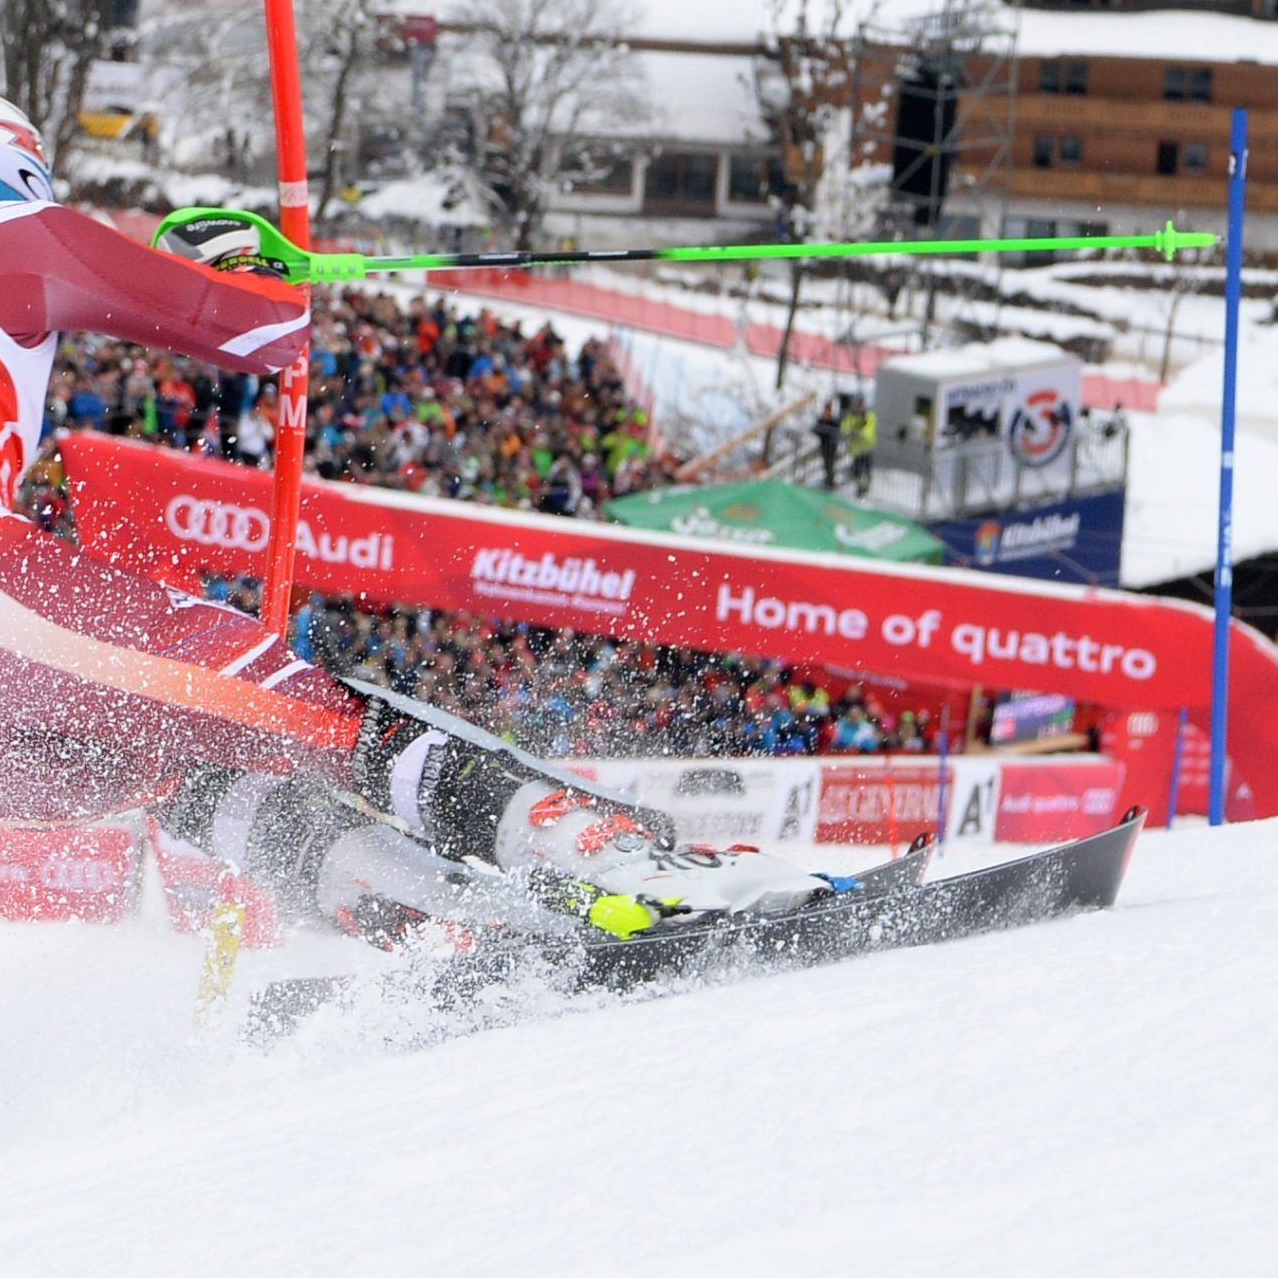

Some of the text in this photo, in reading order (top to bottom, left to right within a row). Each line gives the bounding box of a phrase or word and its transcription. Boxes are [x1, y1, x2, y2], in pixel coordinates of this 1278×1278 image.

[295, 519, 394, 571] Audi
[471, 547, 636, 600] Kitzbühel
[716, 583, 869, 639] Home
[881, 610, 941, 648] of
[950, 623, 1157, 680] quattro
